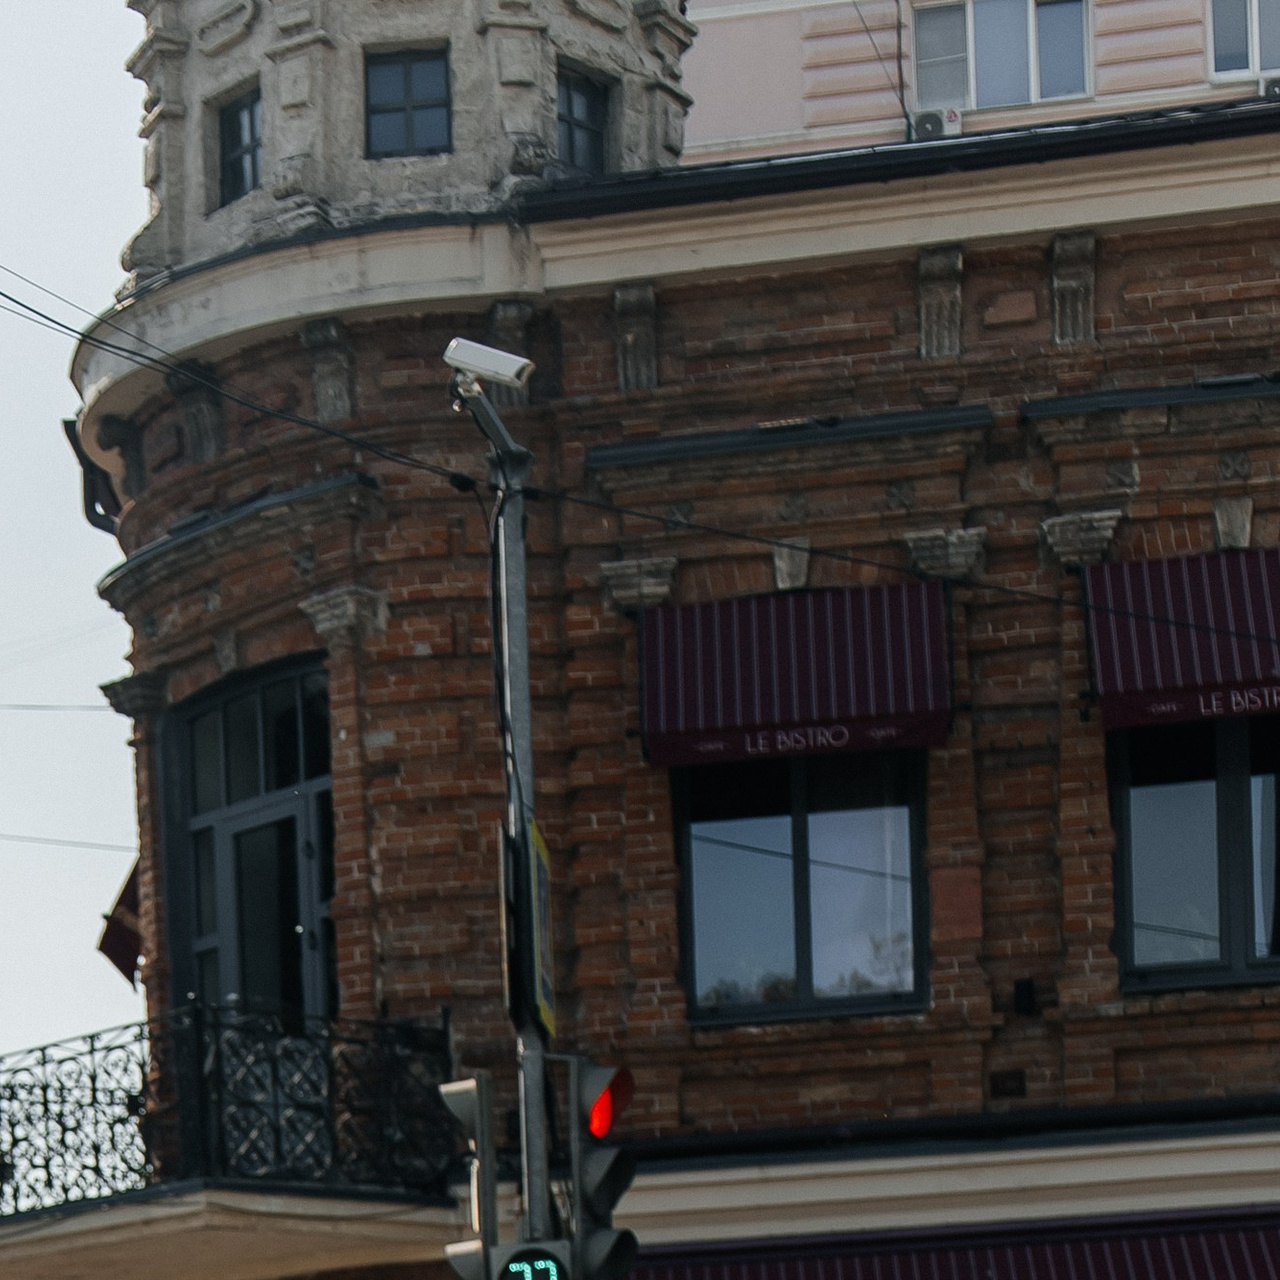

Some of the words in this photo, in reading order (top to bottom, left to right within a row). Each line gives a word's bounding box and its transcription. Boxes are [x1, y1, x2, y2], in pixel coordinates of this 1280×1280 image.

[1199, 691, 1224, 716] LE
[1230, 685, 1280, 713] BISTR
[744, 731, 770, 755] LE
[776, 724, 850, 752] BISTRO
